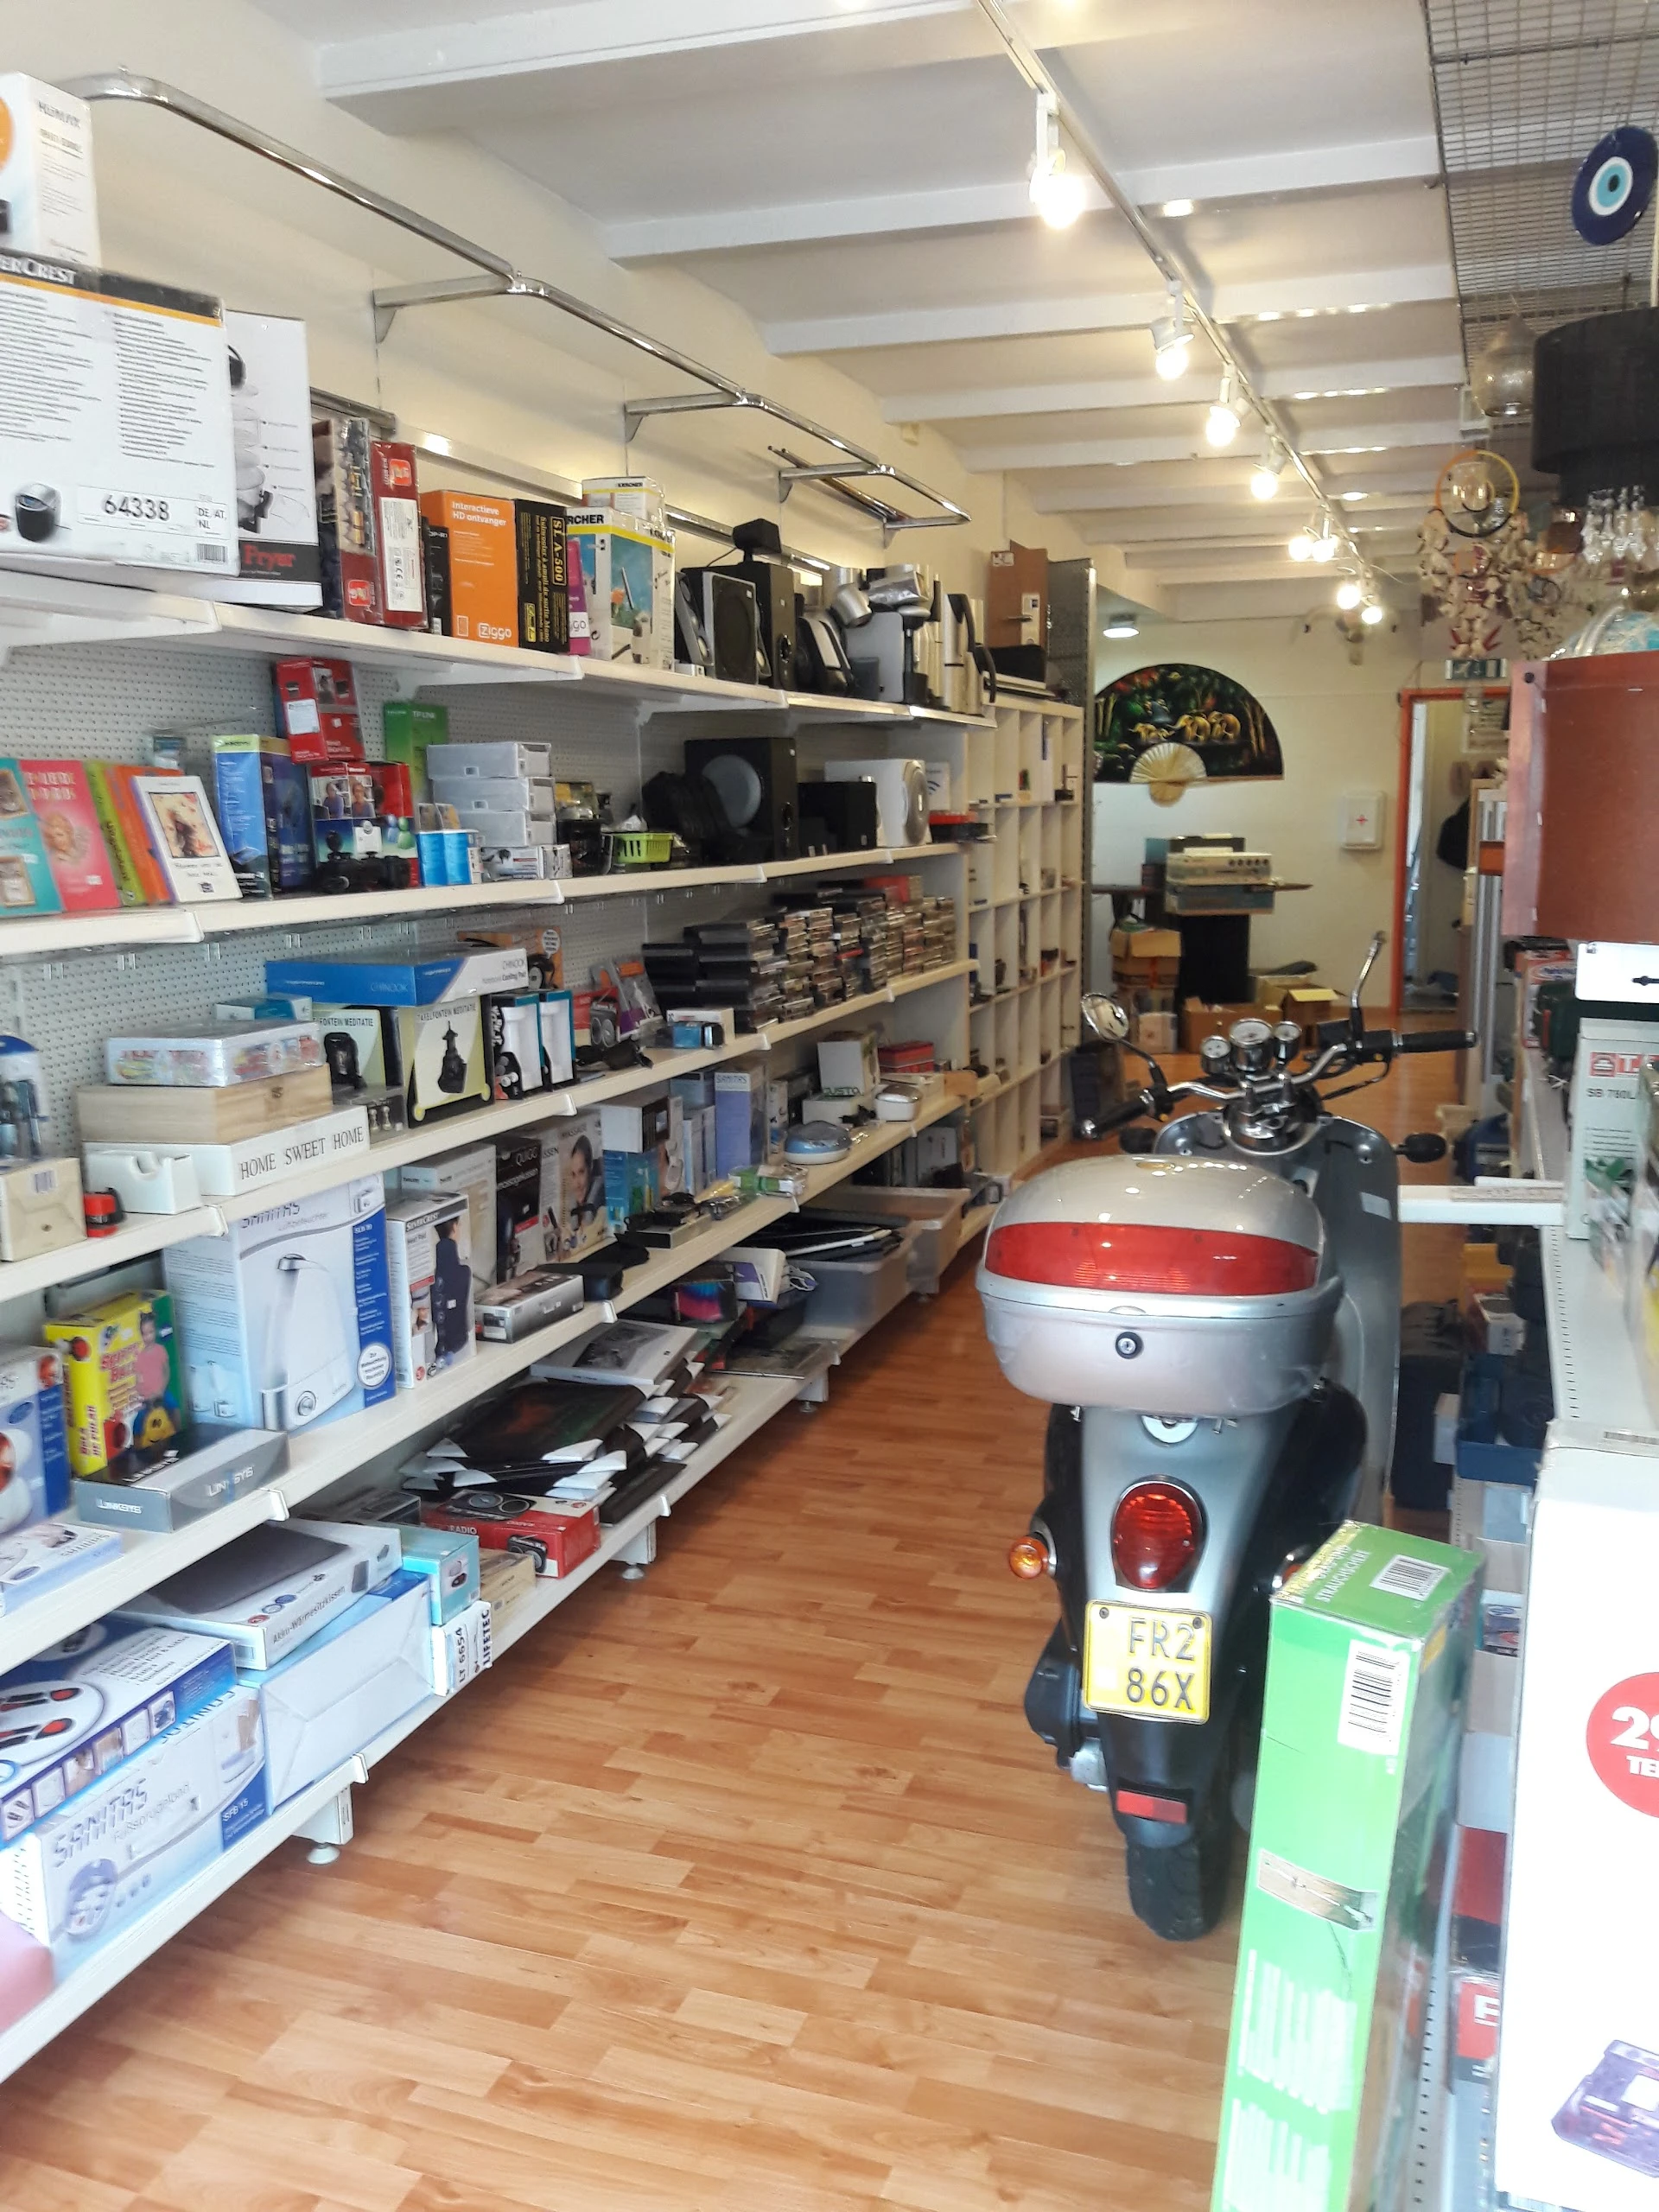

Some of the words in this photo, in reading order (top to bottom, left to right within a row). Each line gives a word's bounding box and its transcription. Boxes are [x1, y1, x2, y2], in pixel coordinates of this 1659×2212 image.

[103, 493, 170, 522] 64338
[452, 501, 500, 516] Interactieve
[452, 512, 466, 520] HD
[467, 513, 507, 527] ontvanger
[243, 543, 297, 570] Fryer
[478, 621, 513, 641] Ziggo
[345, 1018, 374, 1027] MEDITATIE
[1586, 1089, 1605, 1098] SB
[240, 1152, 277, 1180] HOME
[283, 1137, 327, 1166] SWEET
[333, 1126, 365, 1151] HOME
[450, 1525, 478, 1535] RADIO
[272, 1585, 346, 1645] Akku-Wärmesitzkissen
[455, 1627, 466, 1664] 6654
[481, 1608, 492, 1667] LIFETEC
[1128, 1617, 1195, 1662] FR2
[459, 1670, 467, 1684] LT
[1126, 1667, 1195, 1711] 86X
[54, 1777, 149, 1869] SANITAS
